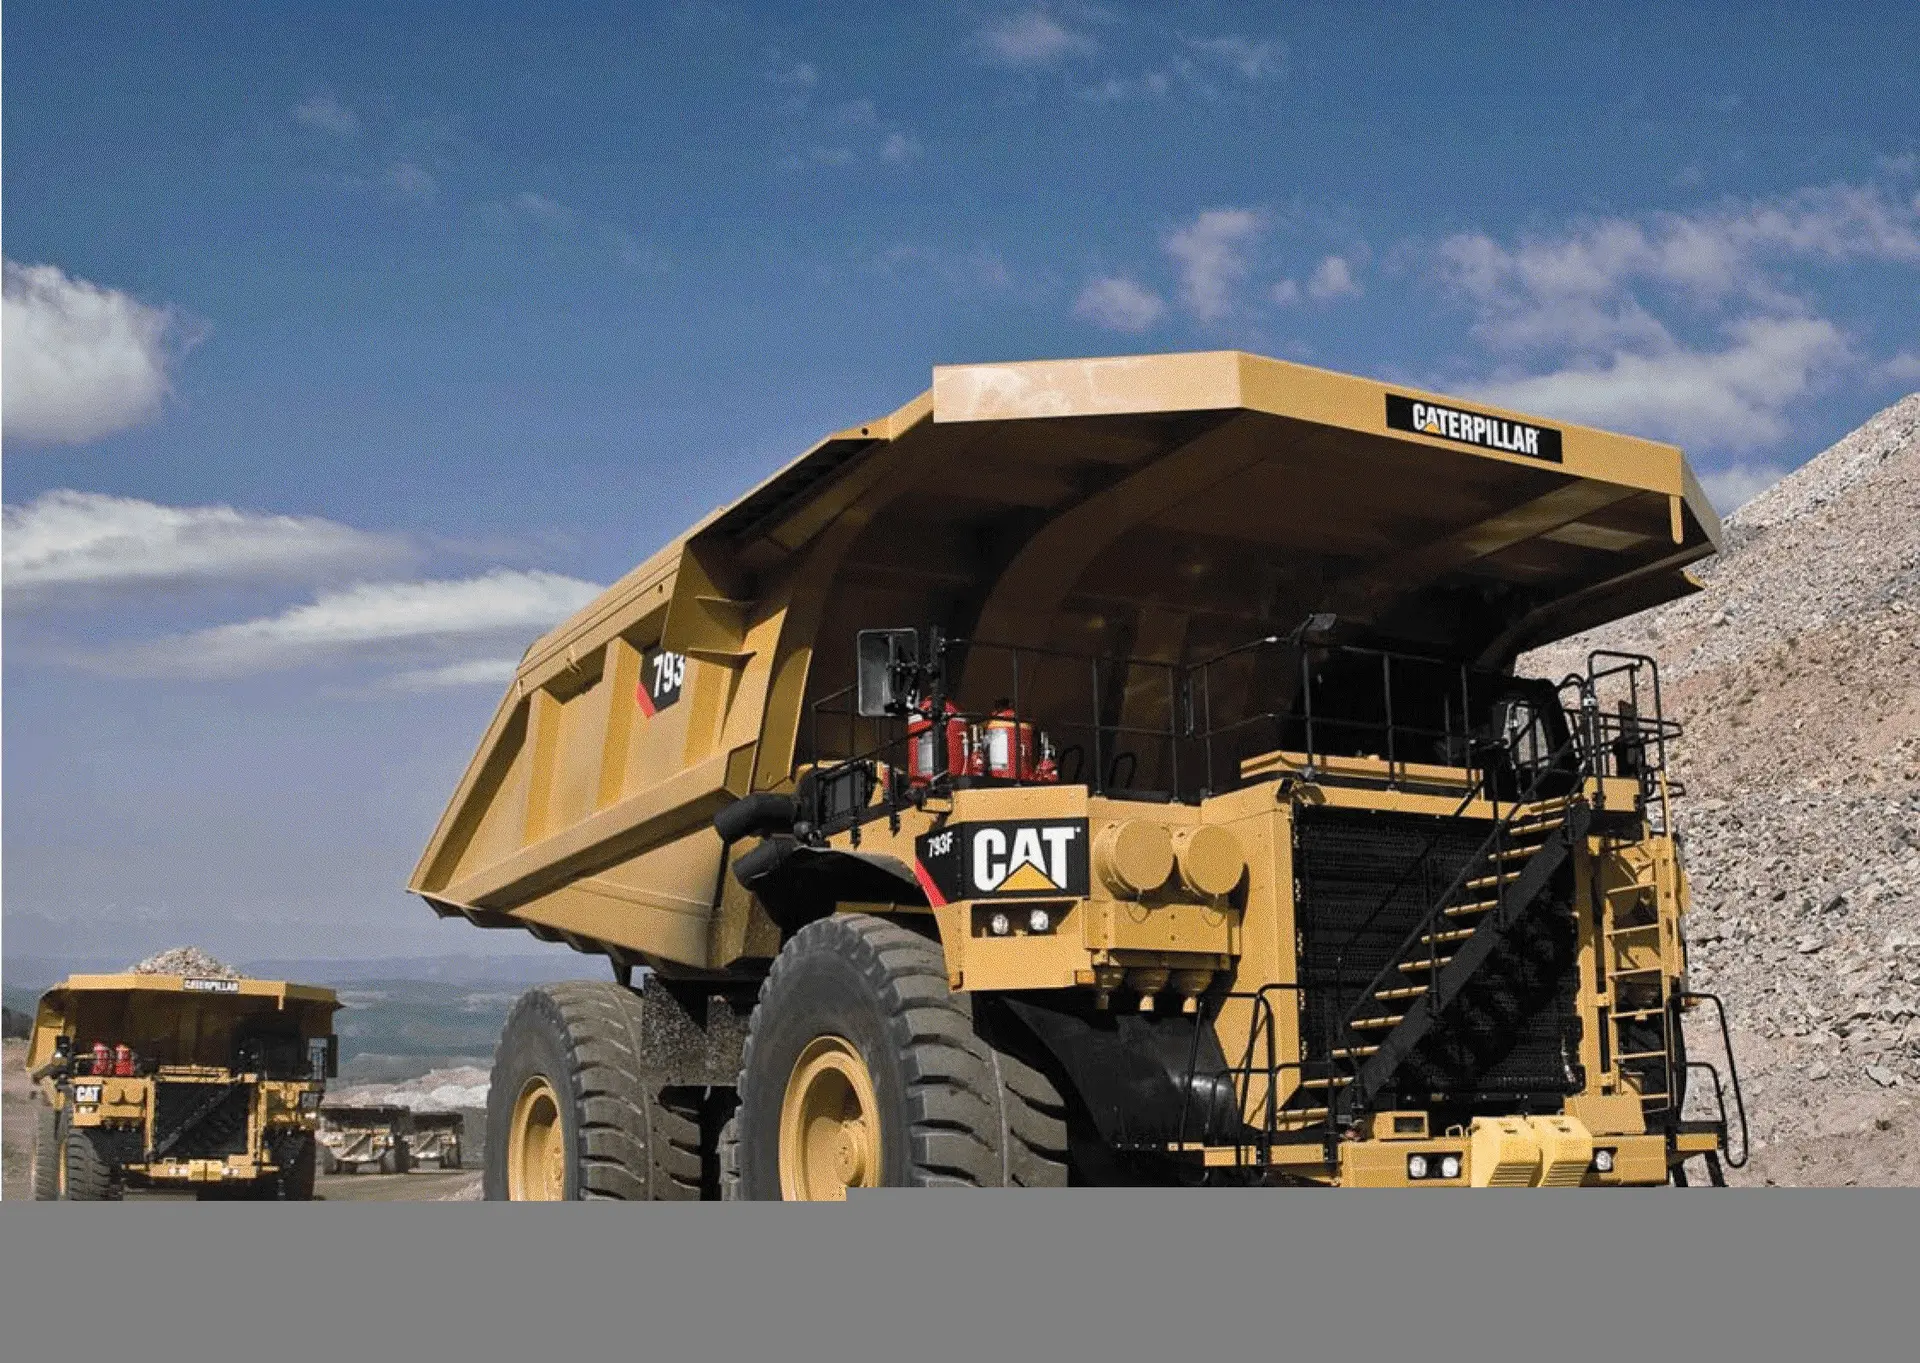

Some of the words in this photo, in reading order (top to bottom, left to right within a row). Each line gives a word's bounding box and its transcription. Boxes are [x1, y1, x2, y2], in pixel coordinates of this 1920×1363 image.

[1412, 403, 1539, 455] CATERPILLAR
[653, 651, 685, 698] 793
[928, 831, 953, 858] 793F
[973, 827, 1075, 891] CAT
[76, 1085, 100, 1102] CAT
